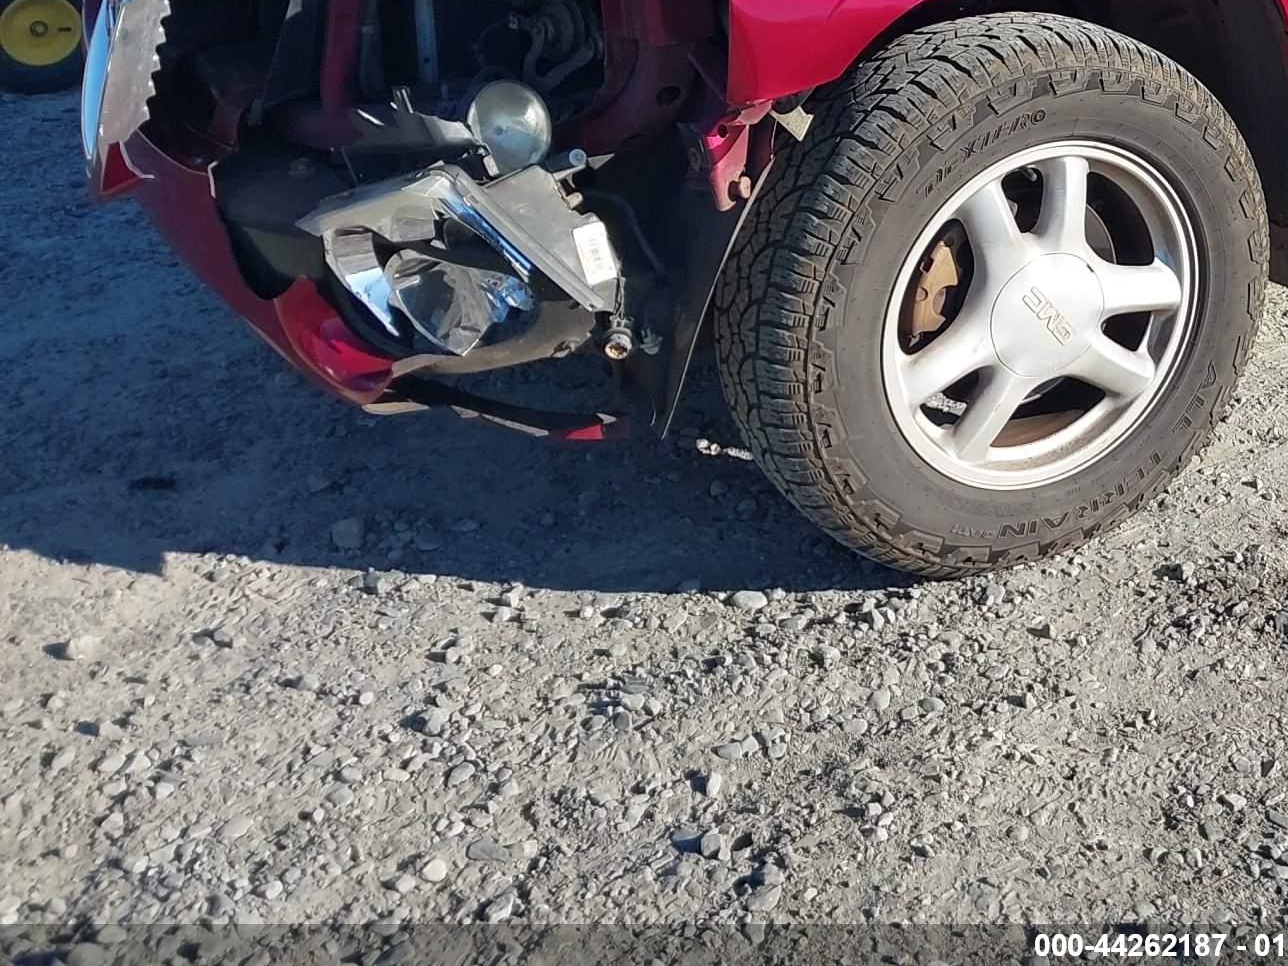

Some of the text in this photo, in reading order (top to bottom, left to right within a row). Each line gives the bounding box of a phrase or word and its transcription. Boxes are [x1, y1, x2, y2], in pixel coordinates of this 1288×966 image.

[1022, 286, 1076, 346] GMC
[999, 360, 1218, 539] ALL TERRAIN
